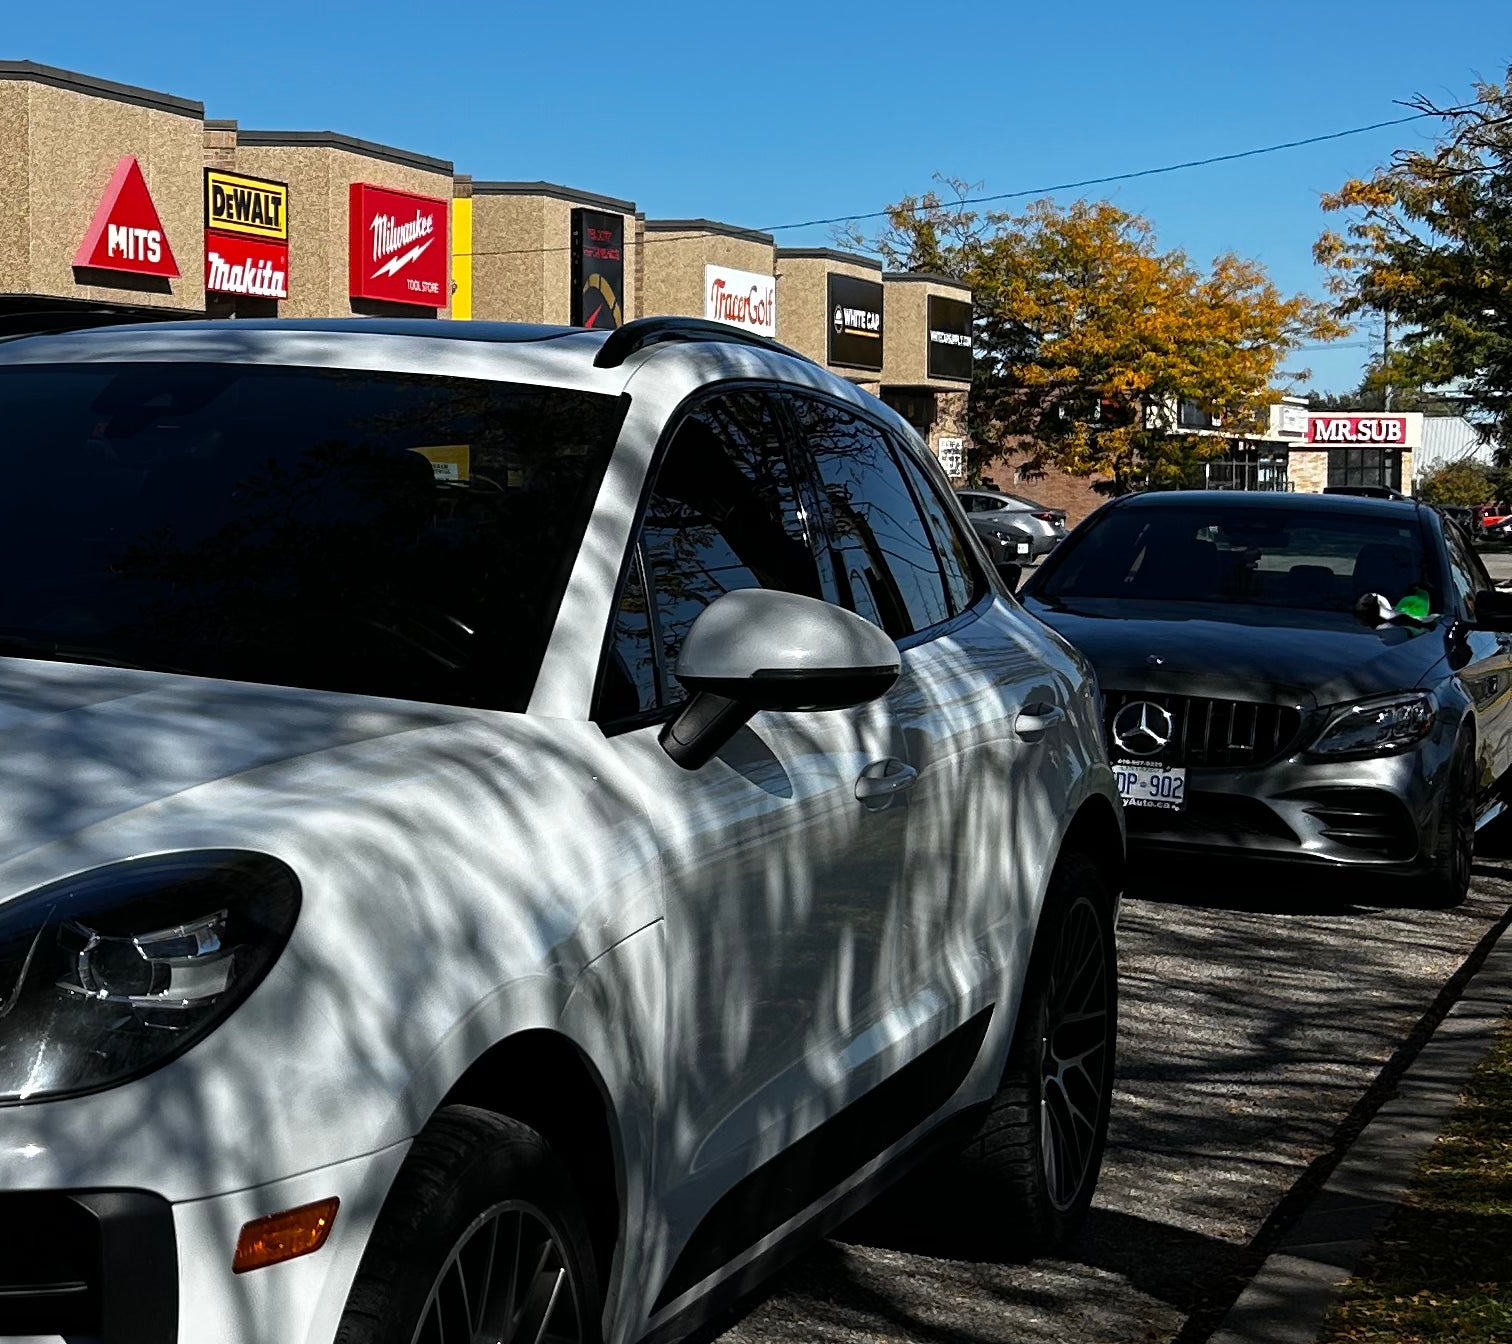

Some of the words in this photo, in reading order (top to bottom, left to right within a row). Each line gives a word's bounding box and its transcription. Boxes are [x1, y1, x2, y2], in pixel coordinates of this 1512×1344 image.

[107, 222, 162, 264] MITS
[370, 209, 434, 262] Milwaukee
[843, 307, 866, 330] WHITE
[1116, 771, 1138, 795] DP
[1149, 774, 1184, 799] 902
[1122, 798, 1171, 809] yAuto.ca
